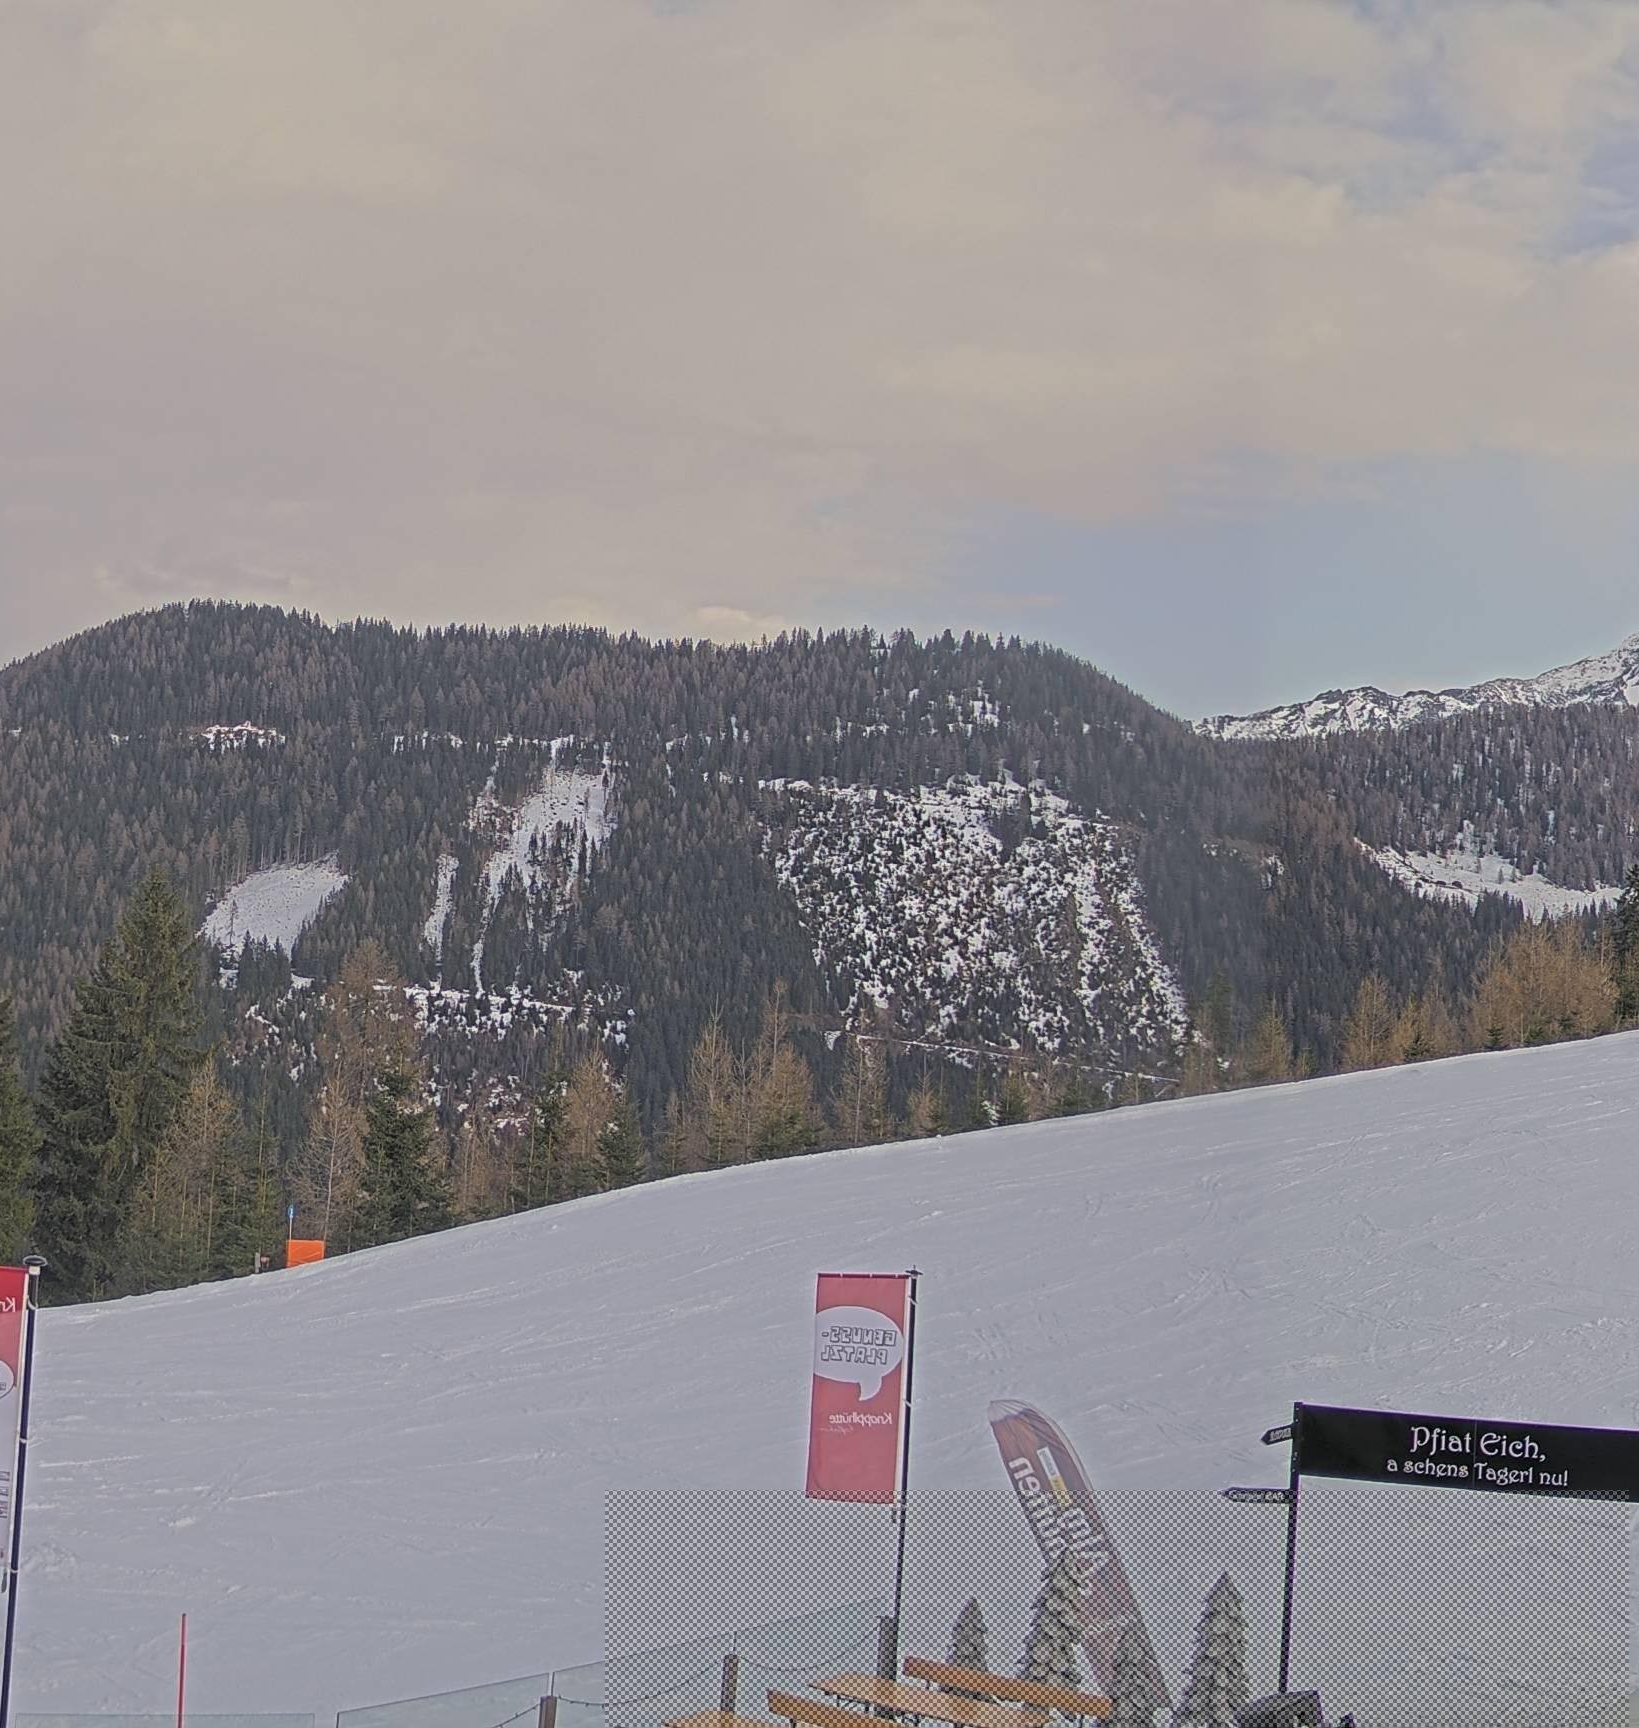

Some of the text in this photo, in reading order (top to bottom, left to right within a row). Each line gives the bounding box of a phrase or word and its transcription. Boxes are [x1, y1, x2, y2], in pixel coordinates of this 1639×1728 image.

[1410, 1426, 1546, 1462] Pfiat Eich,
[1387, 1459, 1568, 1487] a schens Tagerl nu!
